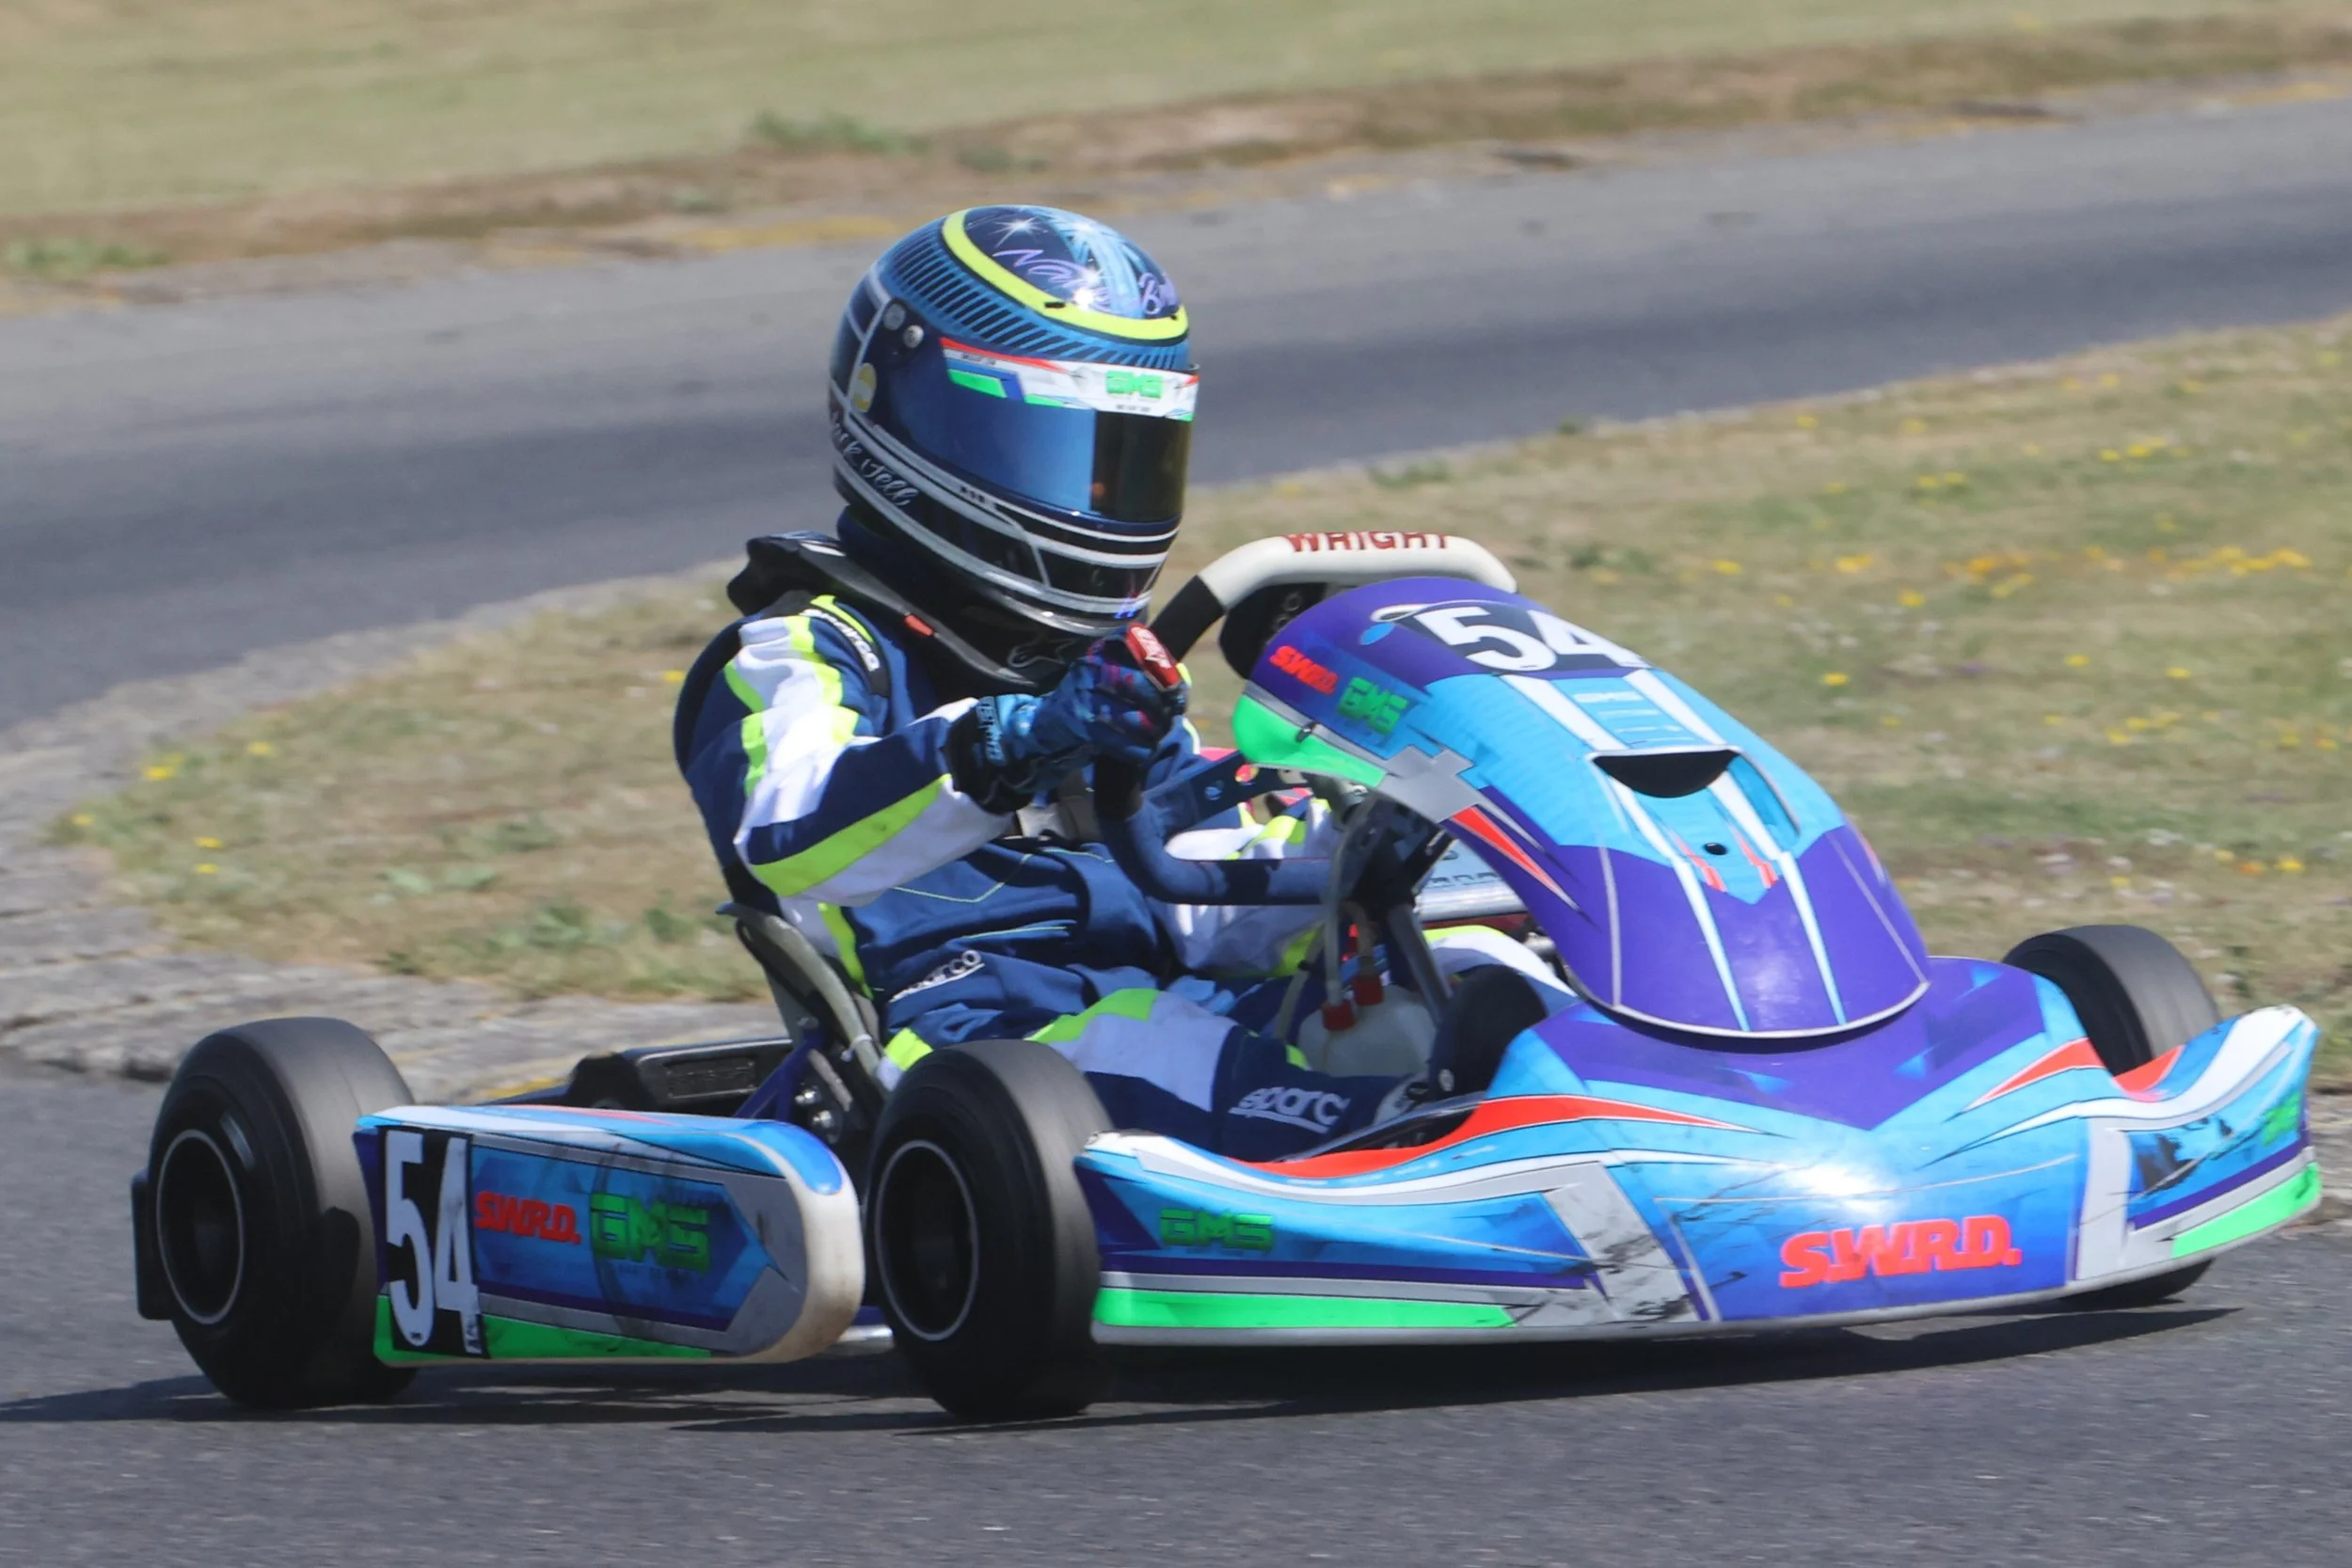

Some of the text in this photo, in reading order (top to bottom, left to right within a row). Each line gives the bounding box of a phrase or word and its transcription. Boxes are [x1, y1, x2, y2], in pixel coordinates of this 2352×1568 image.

[1413, 606, 1652, 672] 54
[385, 1130, 483, 1354] 54
[589, 1193, 712, 1273] GMS
[1160, 1208, 1274, 1254] GMS
